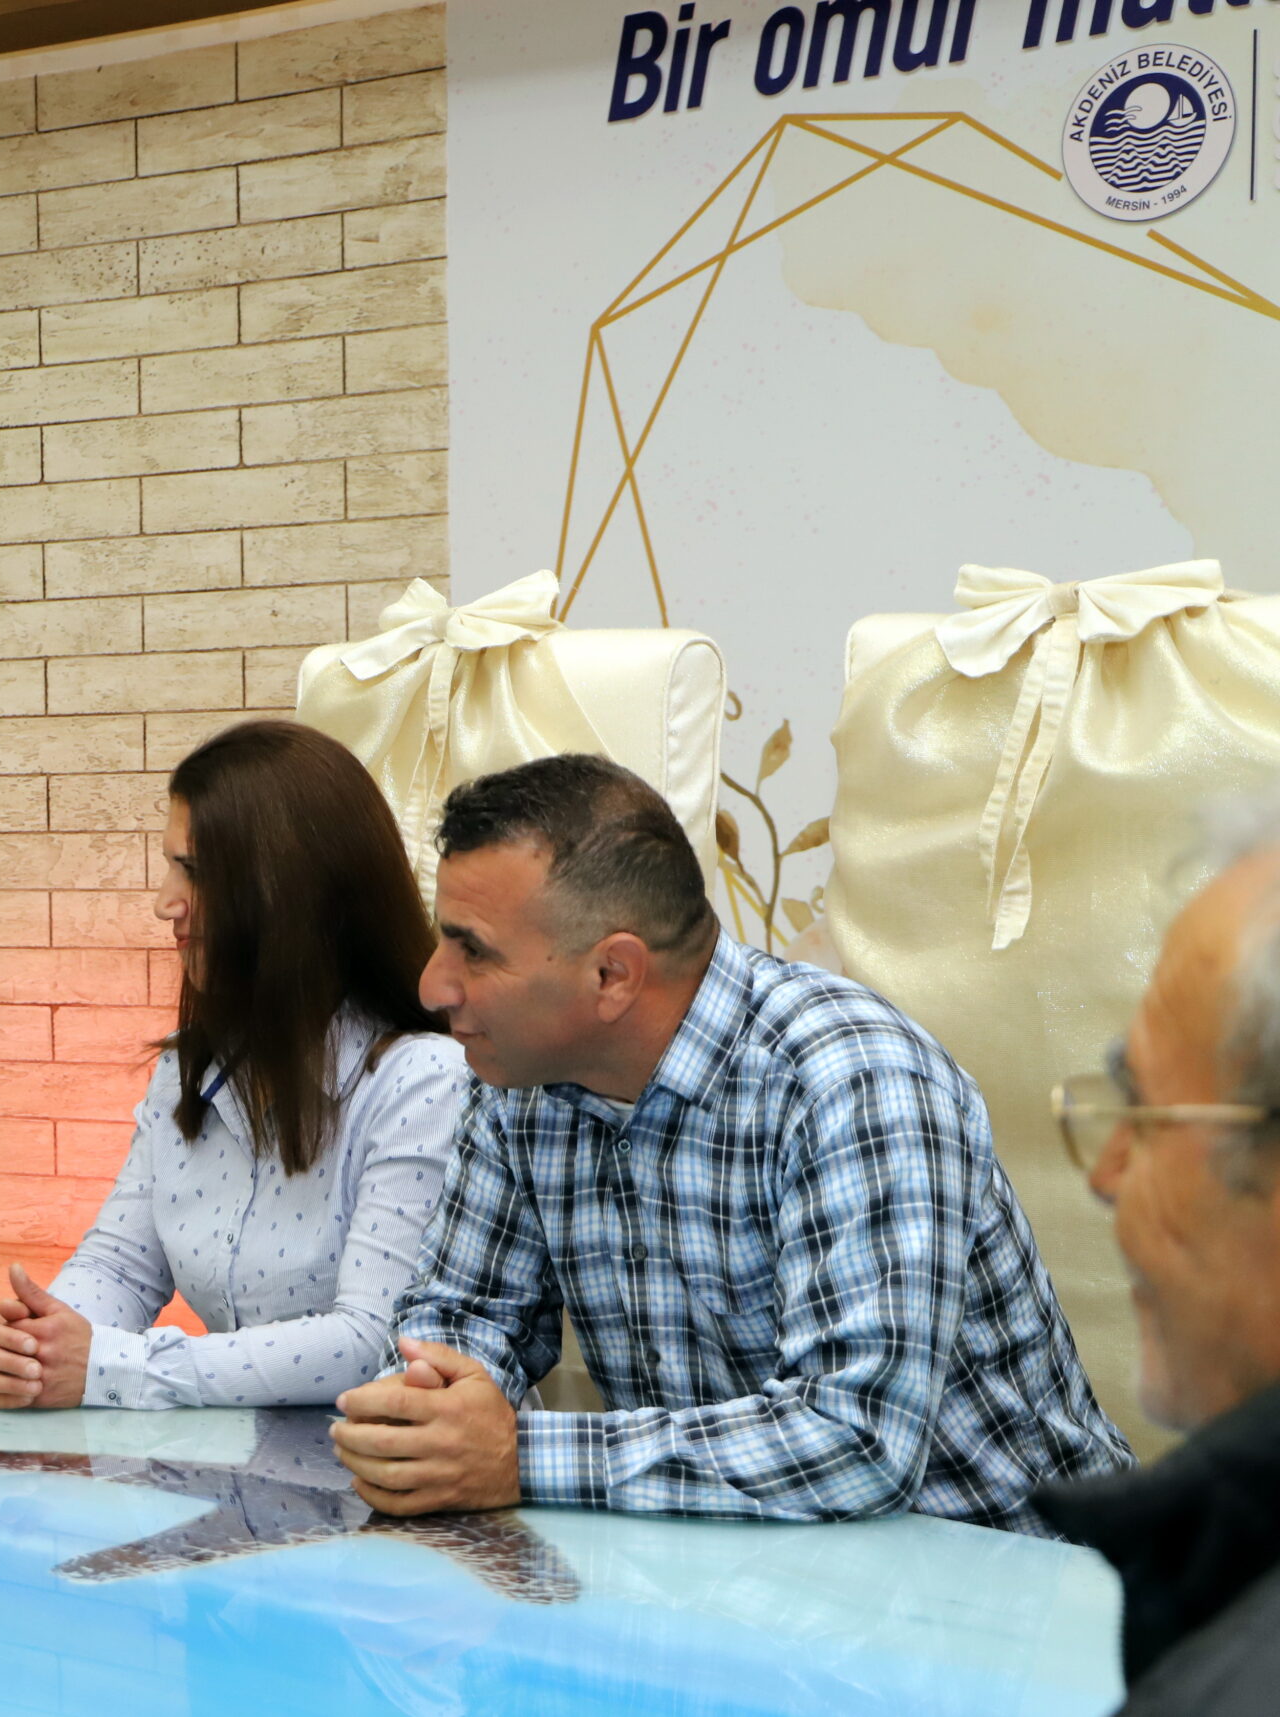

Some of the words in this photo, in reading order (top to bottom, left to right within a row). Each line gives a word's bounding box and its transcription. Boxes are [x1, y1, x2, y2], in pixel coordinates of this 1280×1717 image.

[608, 2, 731, 123] Bir
[1070, 60, 1132, 142] AKDENİZ
[1137, 51, 1232, 122] BELEDİYESİ
[1105, 195, 1150, 211] MERSİN
[1161, 184, 1187, 204] 1994
